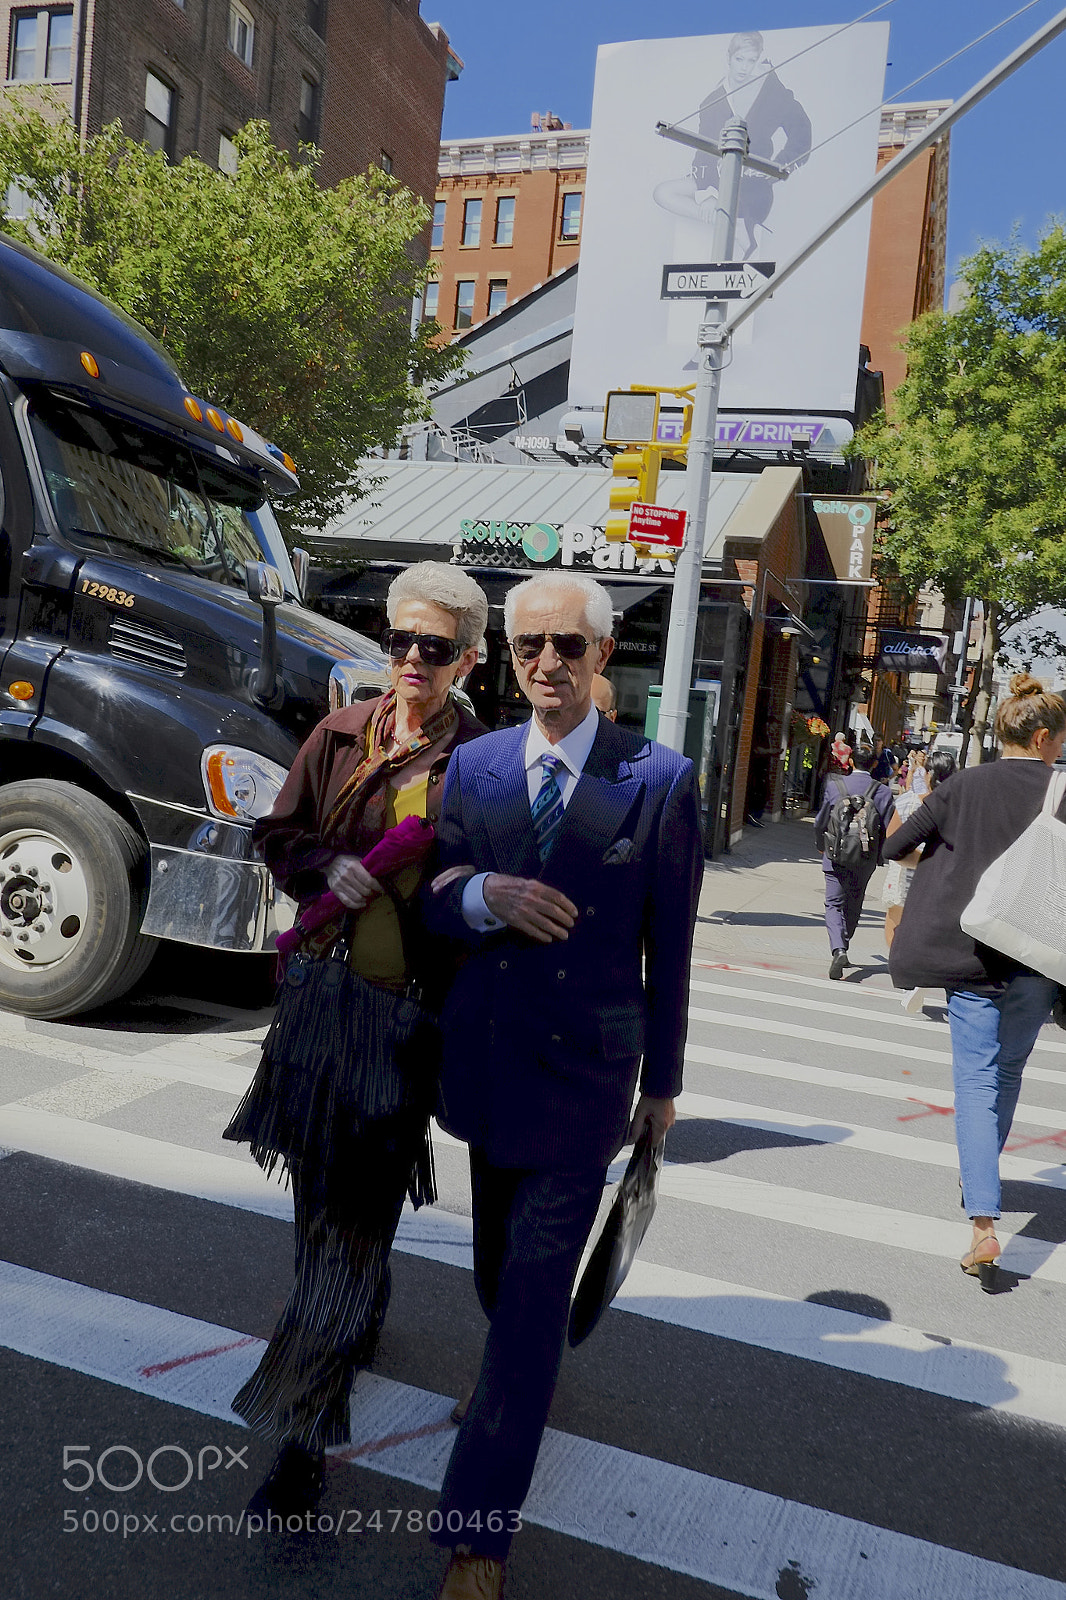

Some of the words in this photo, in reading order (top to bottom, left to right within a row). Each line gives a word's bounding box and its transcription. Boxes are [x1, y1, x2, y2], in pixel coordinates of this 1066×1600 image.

[677, 275, 709, 289] ONE
[724, 273, 758, 288] WAY
[633, 506, 645, 515] NO
[645, 509, 679, 520] STOPPING
[813, 500, 850, 514] SoHo
[632, 515, 662, 526] Anytime
[460, 519, 523, 542] SoHo
[848, 525, 866, 578] PARK
[82, 579, 135, 608] 129836
[619, 642, 647, 652] PRINCE
